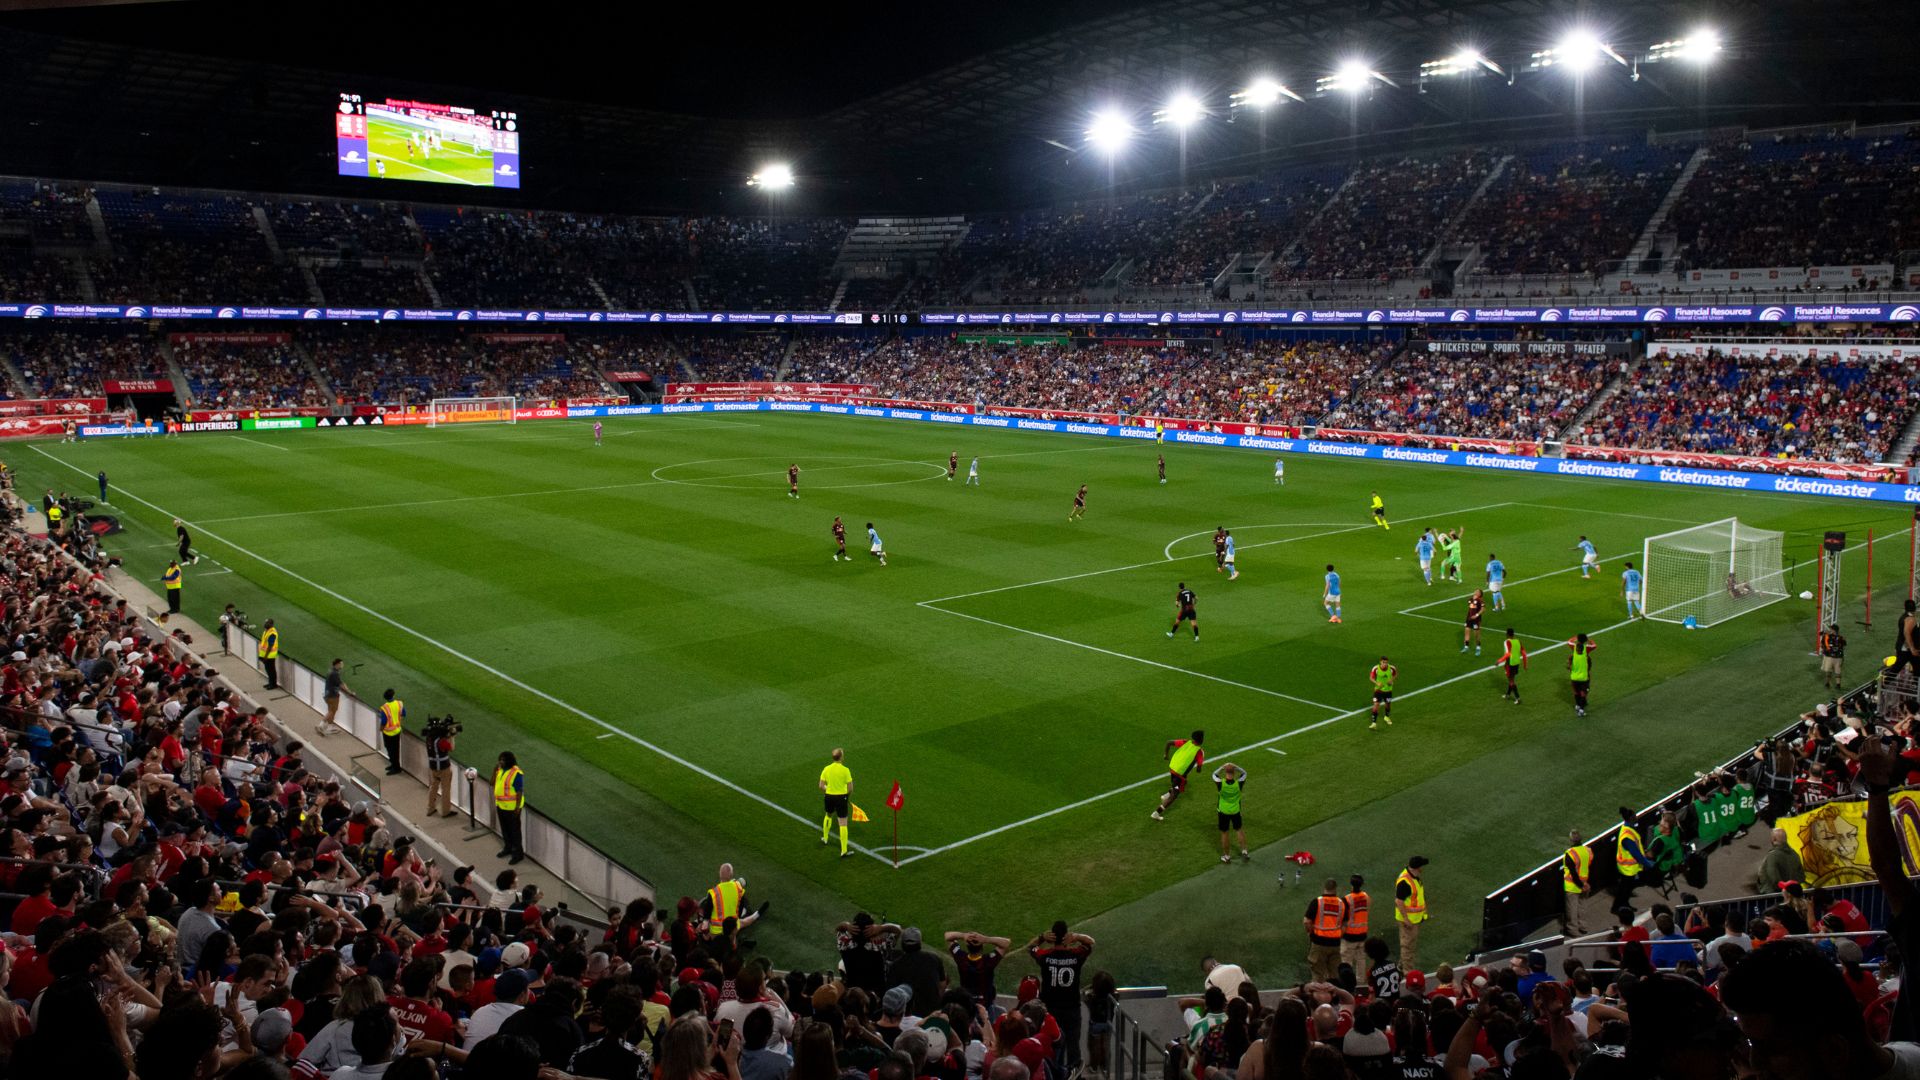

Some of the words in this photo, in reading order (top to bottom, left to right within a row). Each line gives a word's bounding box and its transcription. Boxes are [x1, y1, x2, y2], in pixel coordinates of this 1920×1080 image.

[1675, 308, 1709, 316] Financial
[1711, 308, 1752, 316] Resources
[1795, 306, 1834, 315] Financial
[1835, 306, 1880, 315] Resources
[1493, 344, 1520, 352] SPORTS
[1528, 344, 1566, 353] CONCERTS
[1574, 344, 1606, 354] THEATER
[608, 406, 652, 414] ticketmaster
[663, 404, 704, 412] ticketmaster
[714, 402, 759, 410] ticketmaster
[855, 408, 884, 416] ticketmaster
[892, 410, 922, 418] ticketmaster
[931, 413, 964, 422] ticketmaster
[182, 422, 195, 432] FAN
[196, 420, 238, 431] EXPERIENCES
[973, 416, 1008, 426] ticketmaster
[1018, 420, 1056, 430] ticketmaster
[1067, 424, 1108, 434] ticketmaster
[1120, 426, 1166, 439] ticketmastr
[1176, 432, 1226, 444] ticketmaster
[1240, 436, 1294, 449] ticketmaster
[1308, 442, 1368, 456] ticketmaster
[1382, 448, 1448, 462] ticketmaster
[1466, 454, 1538, 470] ticketmaster
[1558, 462, 1638, 478] ticketmaster
[1660, 468, 1750, 488] ticketmaster
[1775, 477, 1876, 497] ticketmaster
[1184, 594, 1190, 602] 7
[1740, 796, 1754, 808] 22
[1720, 803, 1734, 816] 39
[1704, 810, 1716, 824] 11
[1046, 958, 1078, 966] FORSBERG
[1049, 966, 1074, 988] 10
[1377, 972, 1400, 996] 28
[1402, 1068, 1434, 1078] NAGY
